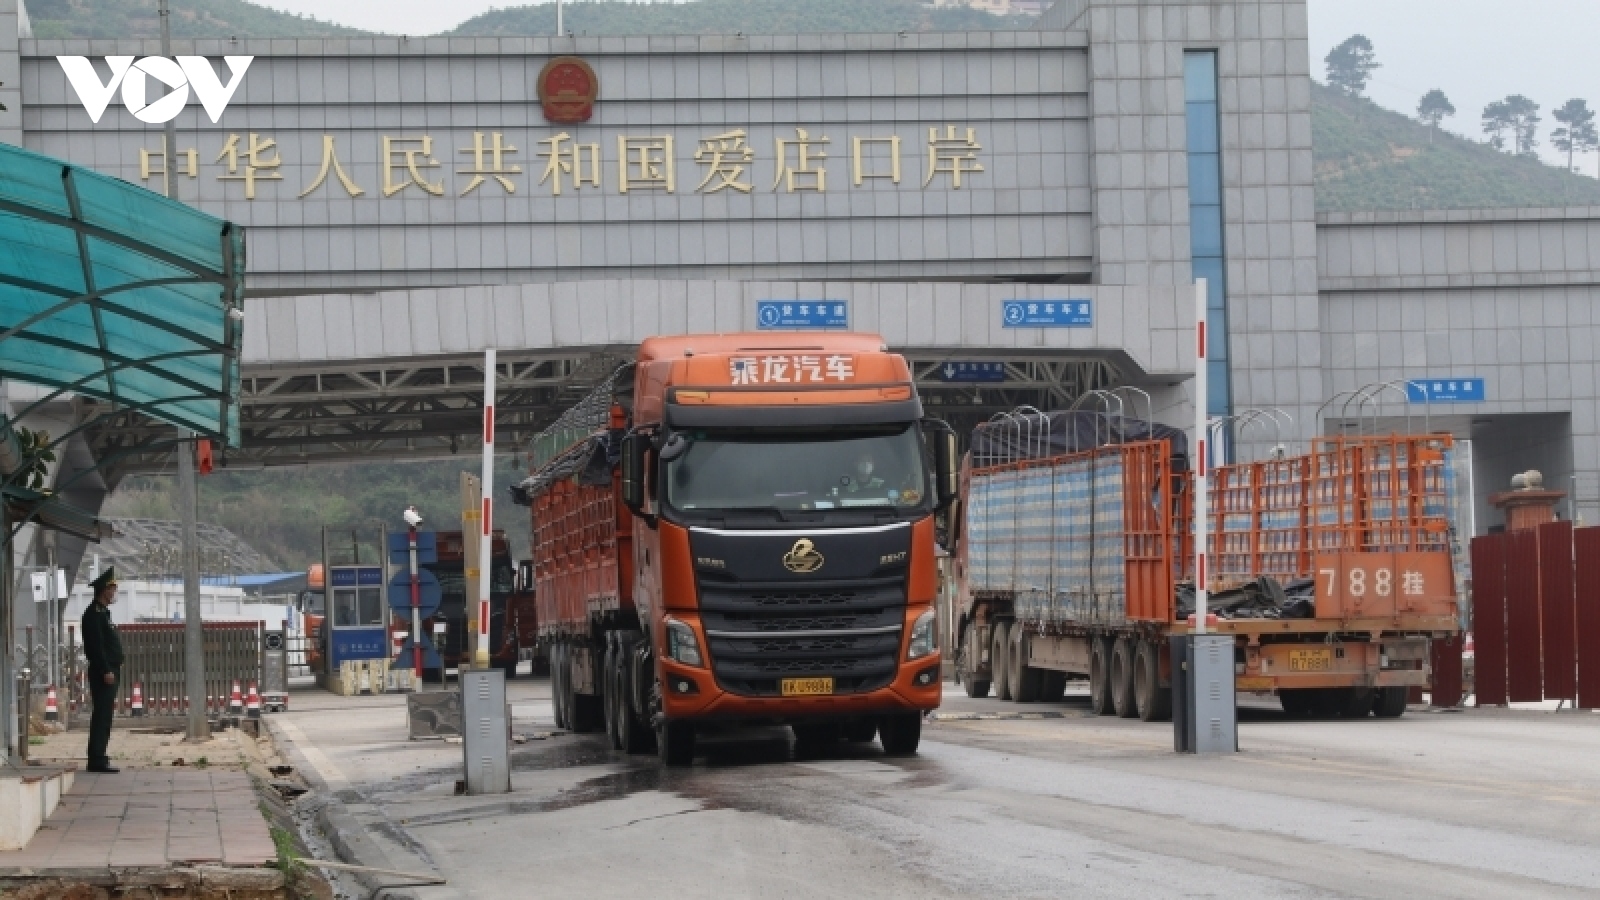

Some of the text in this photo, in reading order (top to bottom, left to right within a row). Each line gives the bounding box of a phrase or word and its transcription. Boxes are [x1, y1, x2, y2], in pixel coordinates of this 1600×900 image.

[139, 125, 985, 200] 中华人民共和国爱店口岸
[729, 355, 855, 384] 乘龙汽车
[1319, 567, 1425, 597] 788挂
